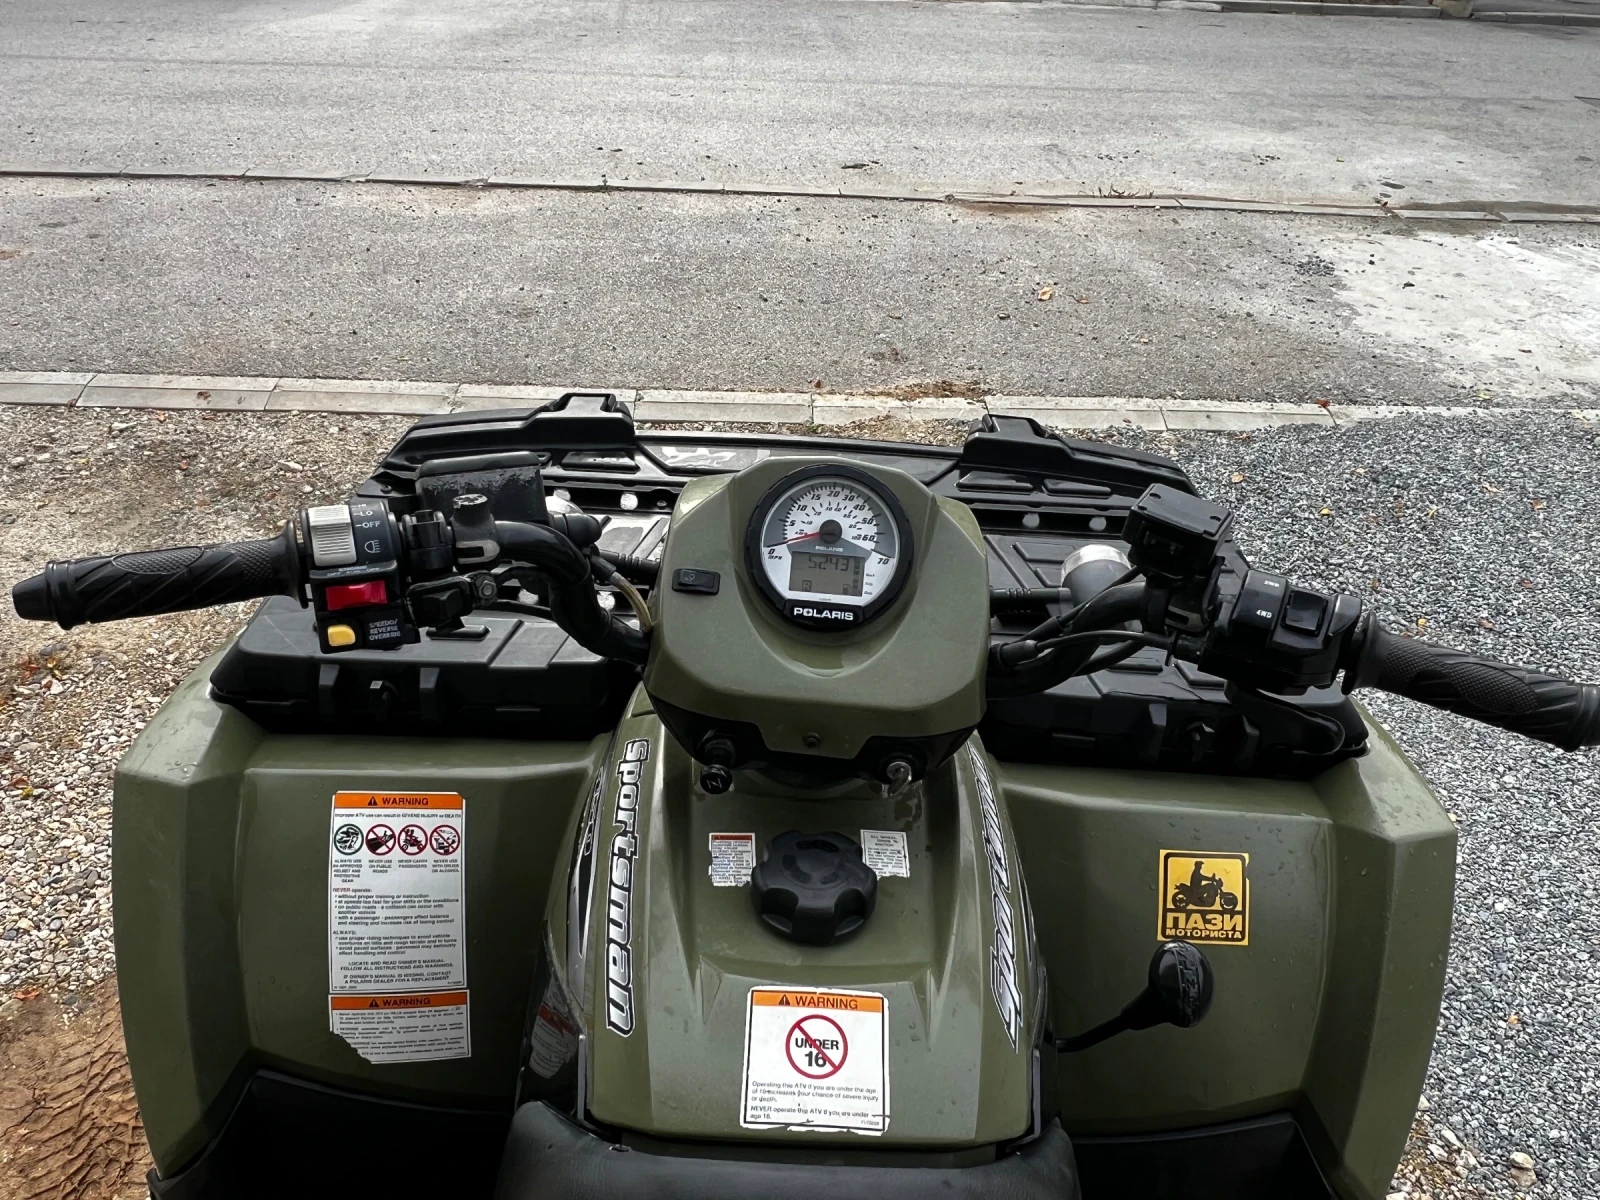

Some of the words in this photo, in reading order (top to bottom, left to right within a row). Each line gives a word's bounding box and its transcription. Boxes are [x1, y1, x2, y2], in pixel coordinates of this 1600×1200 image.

[794, 607, 853, 620] POLARIS
[382, 797, 428, 806] WARNING
[1167, 912, 1242, 931] ПАЗИ
[1166, 929, 1241, 938] МОТОРИСТА
[382, 998, 430, 1007] WARNING
[795, 996, 858, 1010] WARNING
[795, 1038, 839, 1050] UNDER
[805, 1051, 827, 1067] 16
